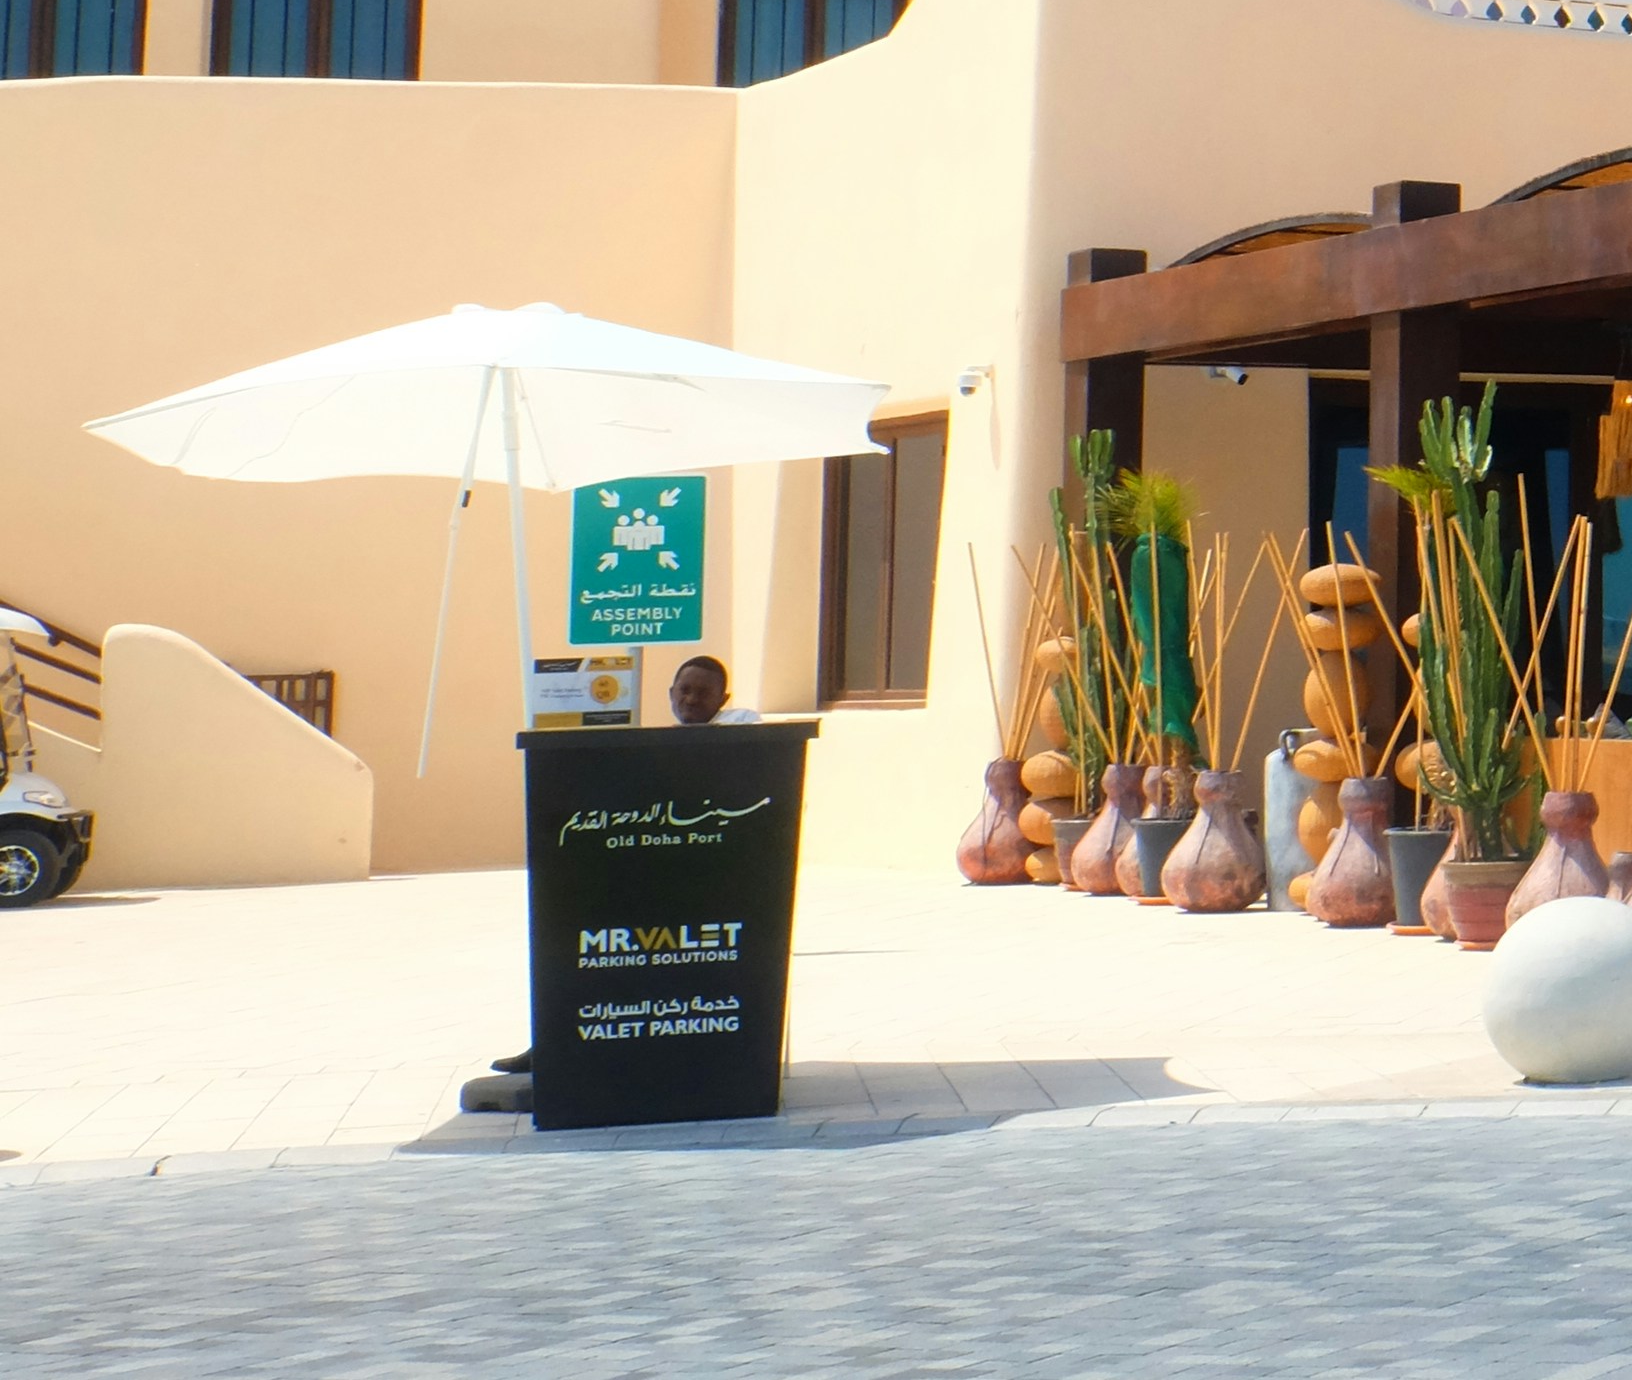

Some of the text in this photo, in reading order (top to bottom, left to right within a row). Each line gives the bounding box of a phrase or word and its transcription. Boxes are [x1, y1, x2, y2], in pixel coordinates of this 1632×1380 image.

[581, 583, 696, 605] نقطة التجمع
[592, 607, 683, 621] ASSEMBLY
[611, 622, 664, 636] POINT
[611, 803, 662, 826] الدوحة
[558, 810, 608, 847] القديم
[606, 832, 723, 849] Old Doha Port
[578, 950, 738, 969] PARKING SOLUTIONS
[578, 995, 740, 1021] خدمة ركن السيارات
[577, 1016, 740, 1041] VALET PARKING
